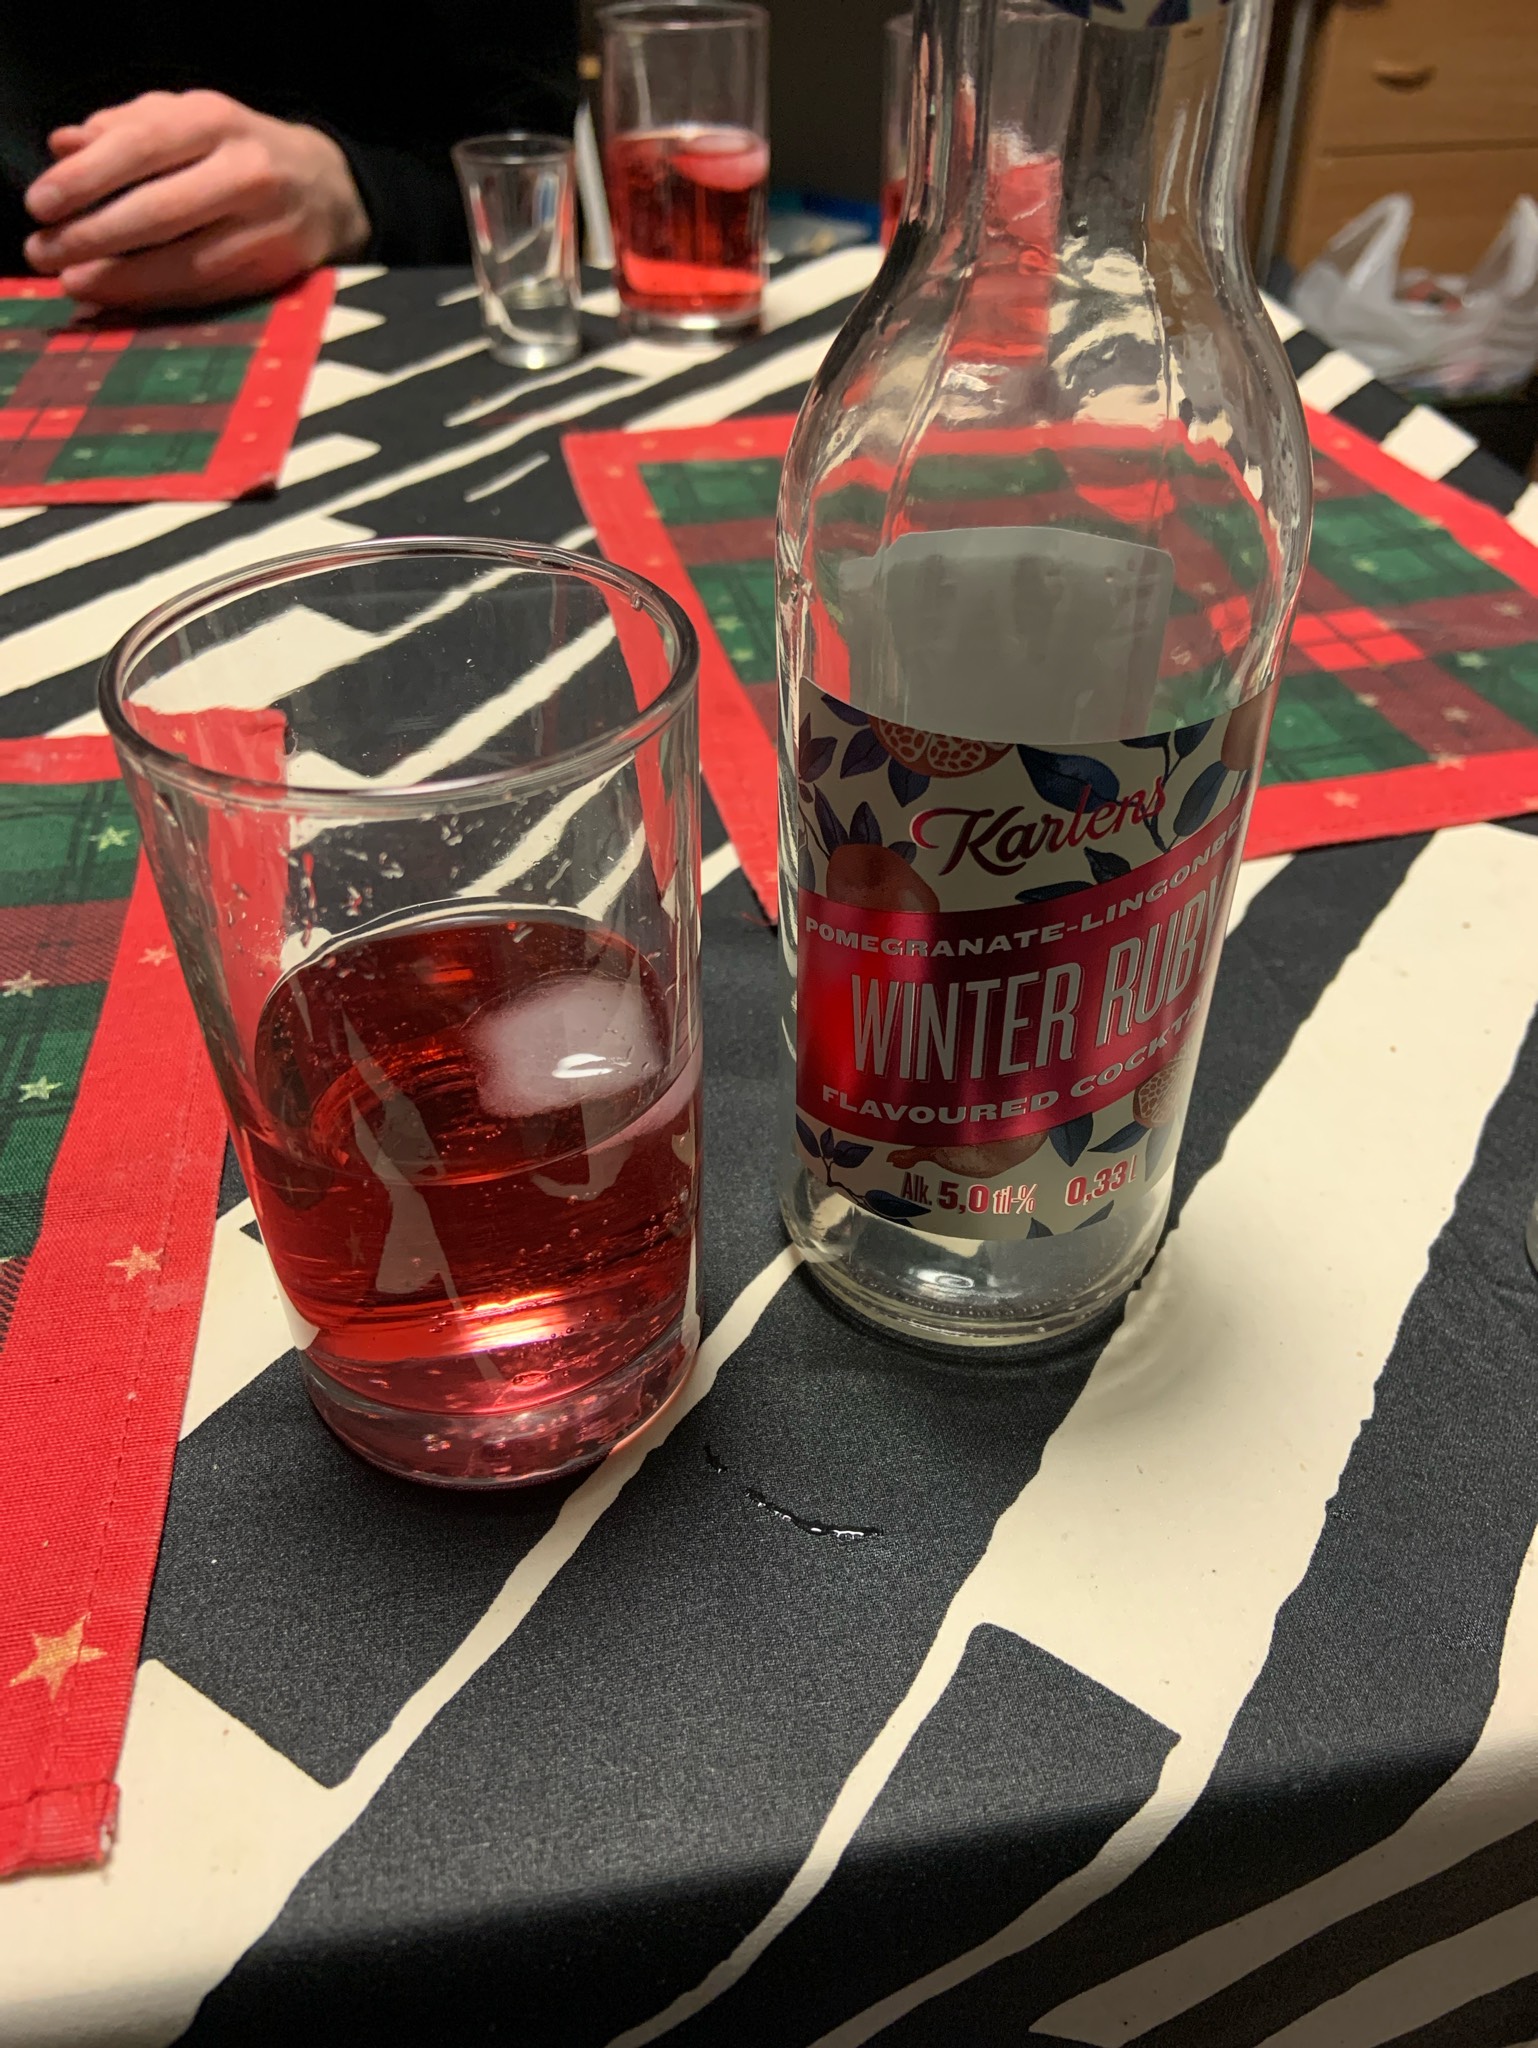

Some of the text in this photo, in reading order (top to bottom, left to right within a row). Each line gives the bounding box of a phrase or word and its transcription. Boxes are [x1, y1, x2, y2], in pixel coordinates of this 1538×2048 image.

[909, 776, 1167, 876] Karlens
[851, 857, 1231, 1083] WINTER RUBY
[822, 1084, 1060, 1125] FLAVOURED
[902, 1171, 933, 1205] Alk.
[937, 1179, 990, 1214] 5,0
[1064, 1160, 1128, 1207] 0,33
